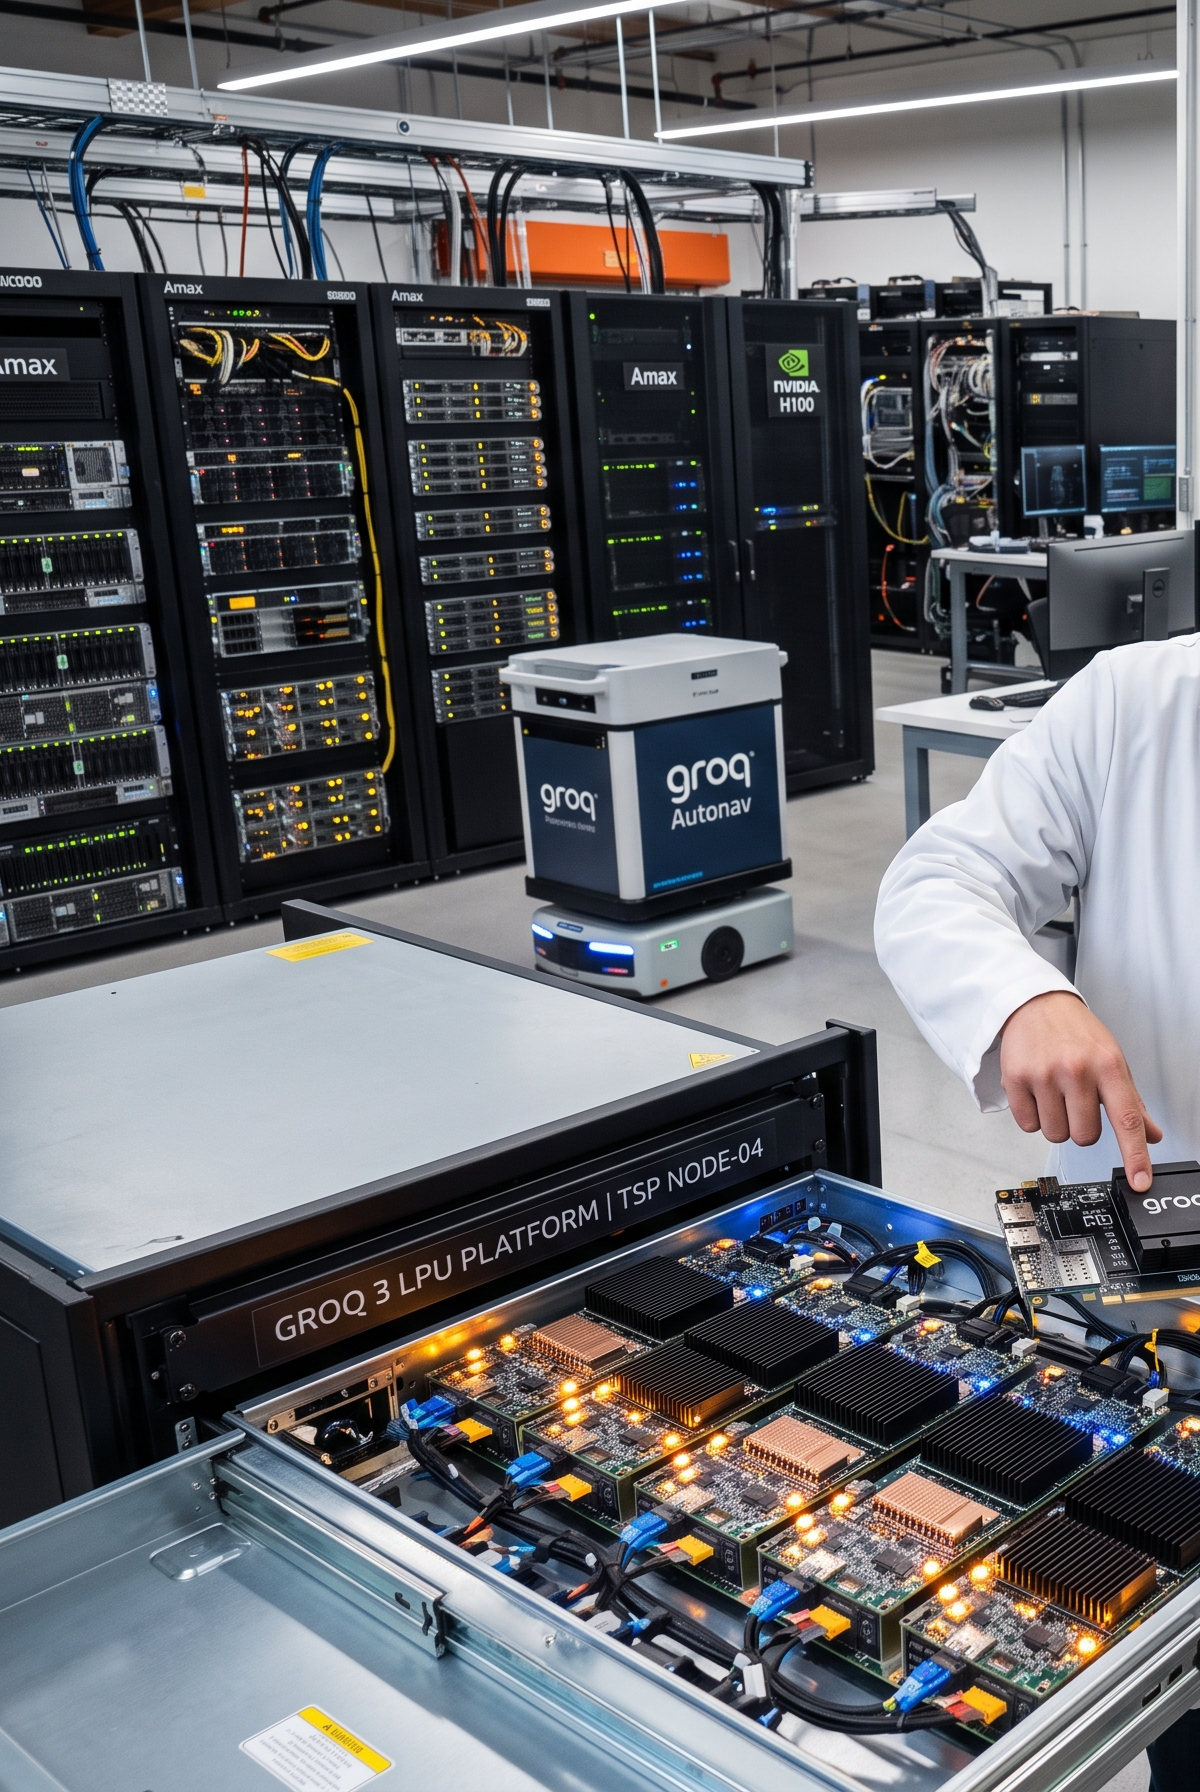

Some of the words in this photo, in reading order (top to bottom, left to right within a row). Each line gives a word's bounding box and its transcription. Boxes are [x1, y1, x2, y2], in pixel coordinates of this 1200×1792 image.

[164, 281, 203, 295] Amax
[391, 290, 424, 302] Amax
[631, 367, 677, 385] Amax
[780, 397, 814, 412] H100
[671, 797, 752, 830] Autonav
[275, 1290, 367, 1341] GROQ
[373, 1279, 391, 1305] 3
[398, 1254, 453, 1296] LPU
[460, 1199, 600, 1272] PLATFORM
[617, 1176, 661, 1209] TSP
[666, 1137, 764, 1192] NODE-04
